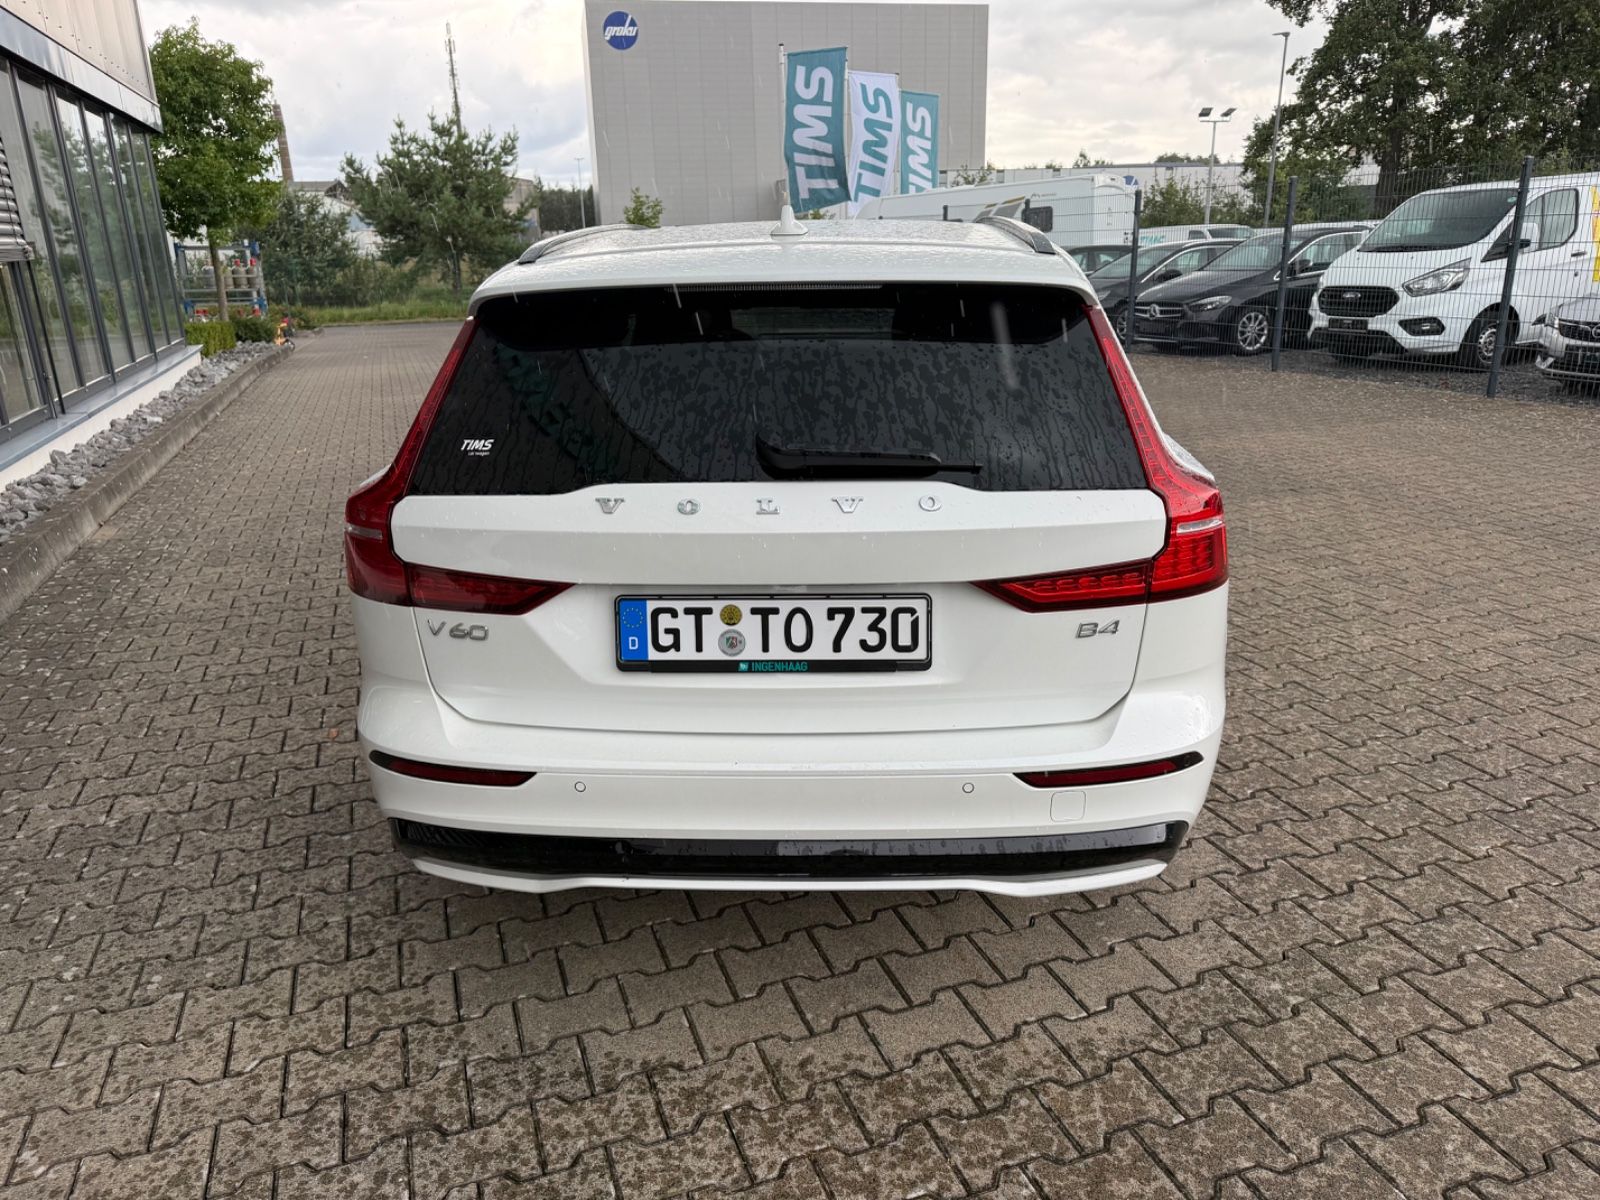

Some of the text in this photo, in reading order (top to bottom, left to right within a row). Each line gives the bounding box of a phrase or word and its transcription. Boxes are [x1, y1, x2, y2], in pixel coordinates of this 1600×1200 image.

[604, 14, 639, 41] groku
[792, 64, 840, 199] TIMS
[853, 82, 894, 203] TIMS
[460, 438, 495, 451] TIMS
[595, 496, 942, 515] VOLVO
[650, 605, 920, 654] GT TO 730
[1075, 619, 1120, 640] B4
[628, 636, 639, 650] D
[751, 661, 808, 672] INGENHAAG
